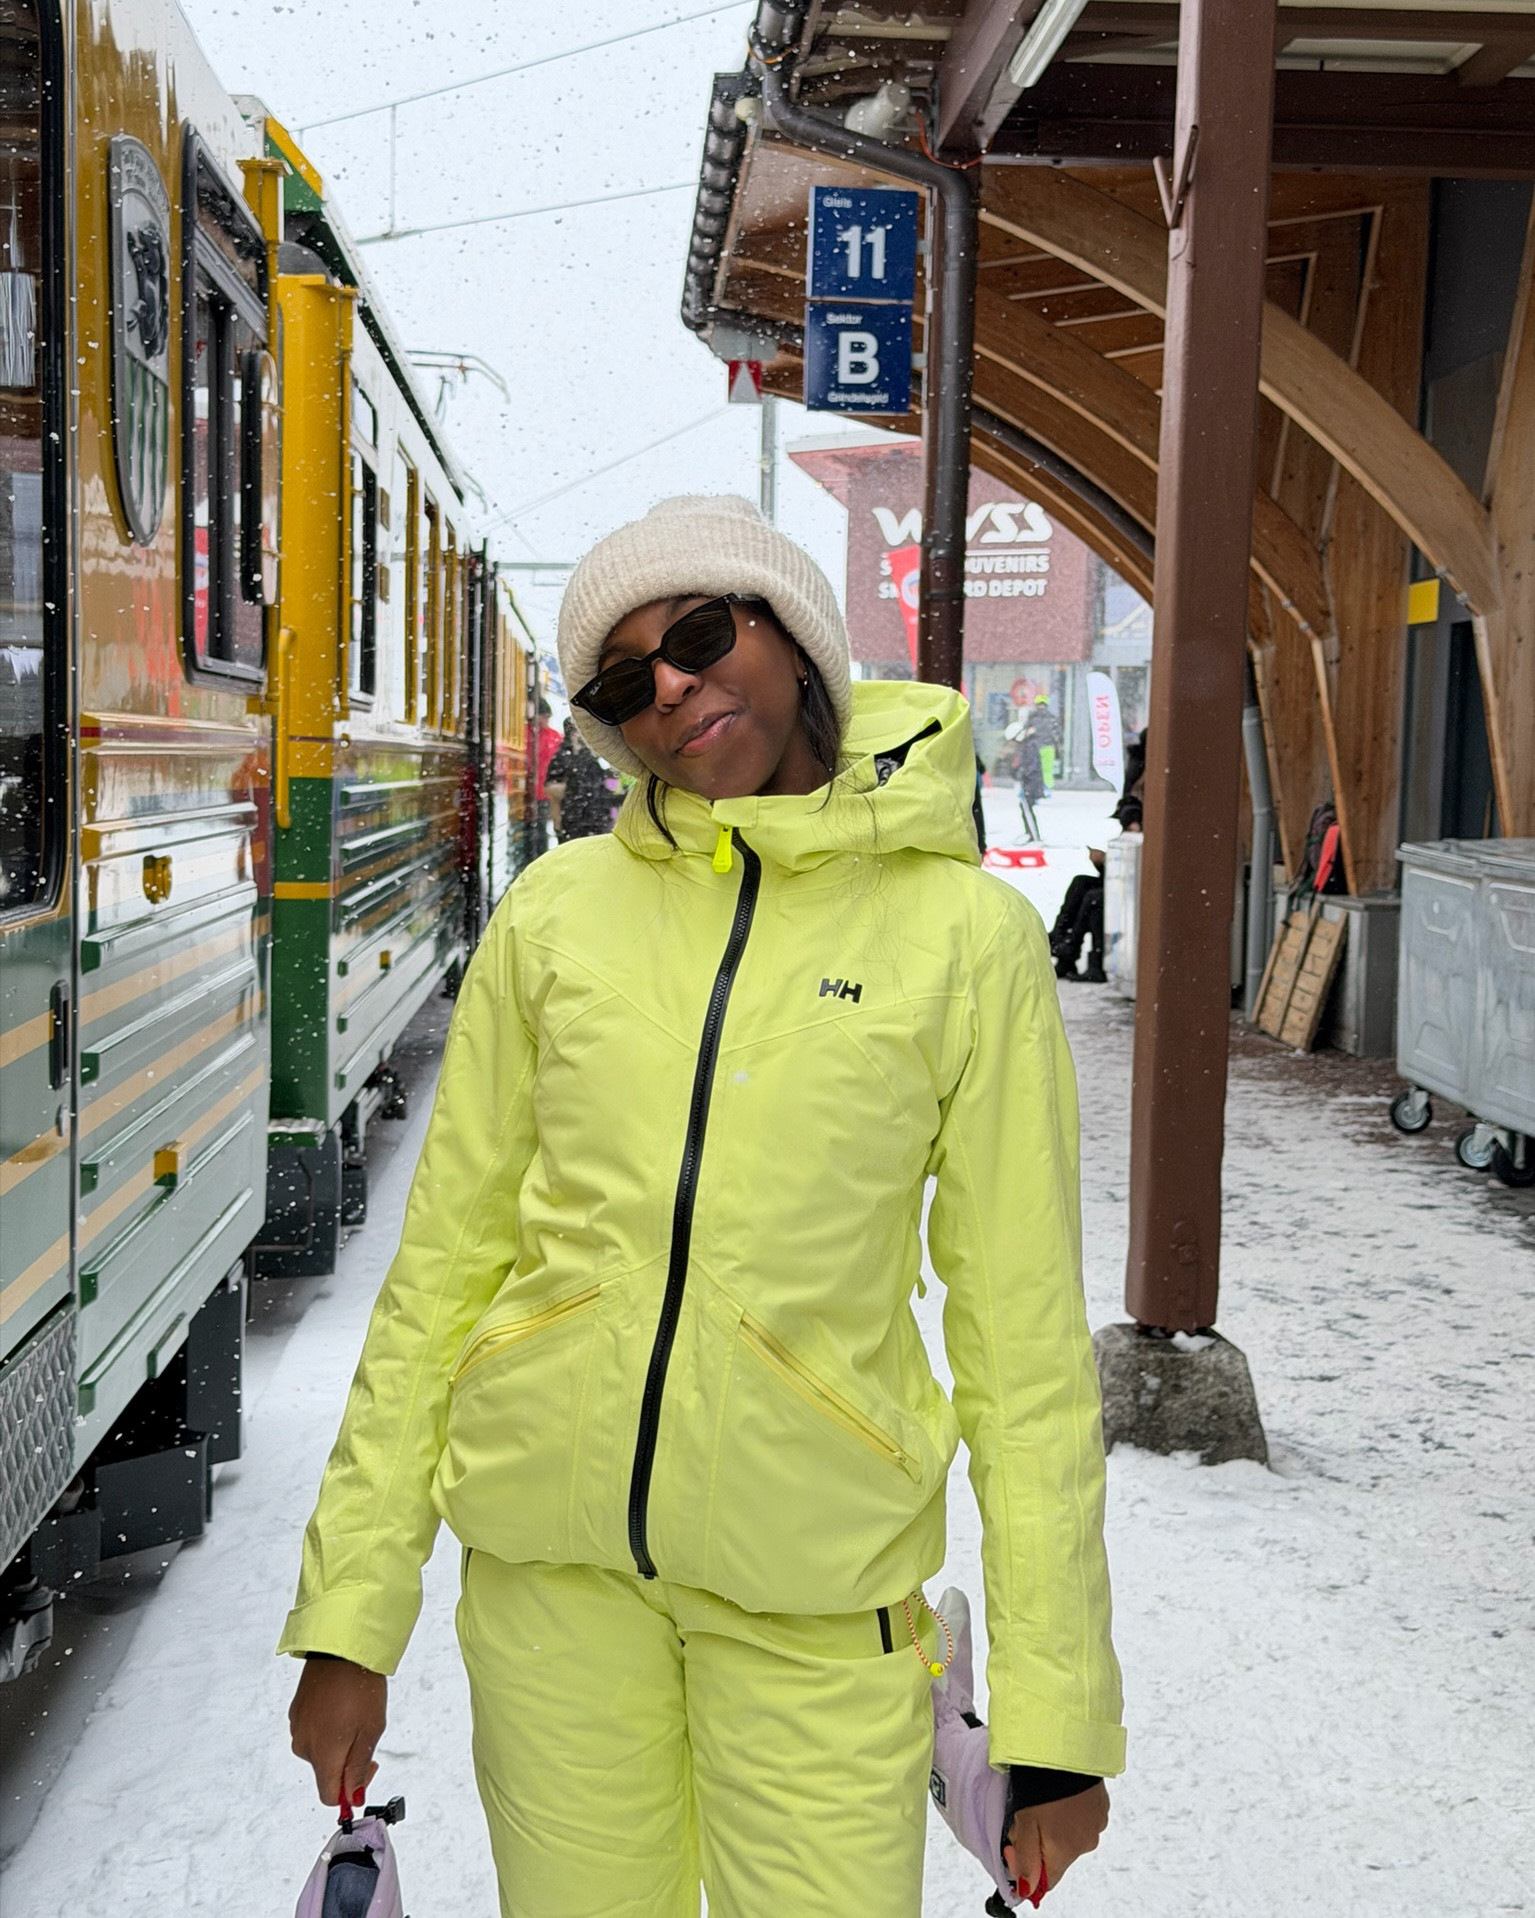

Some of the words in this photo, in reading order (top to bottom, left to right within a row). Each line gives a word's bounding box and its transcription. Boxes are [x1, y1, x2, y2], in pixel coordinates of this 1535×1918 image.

[841, 225, 886, 279] 11
[838, 331, 880, 384] B
[988, 578, 1048, 597] DEPOT
[819, 978, 863, 1004] HH
